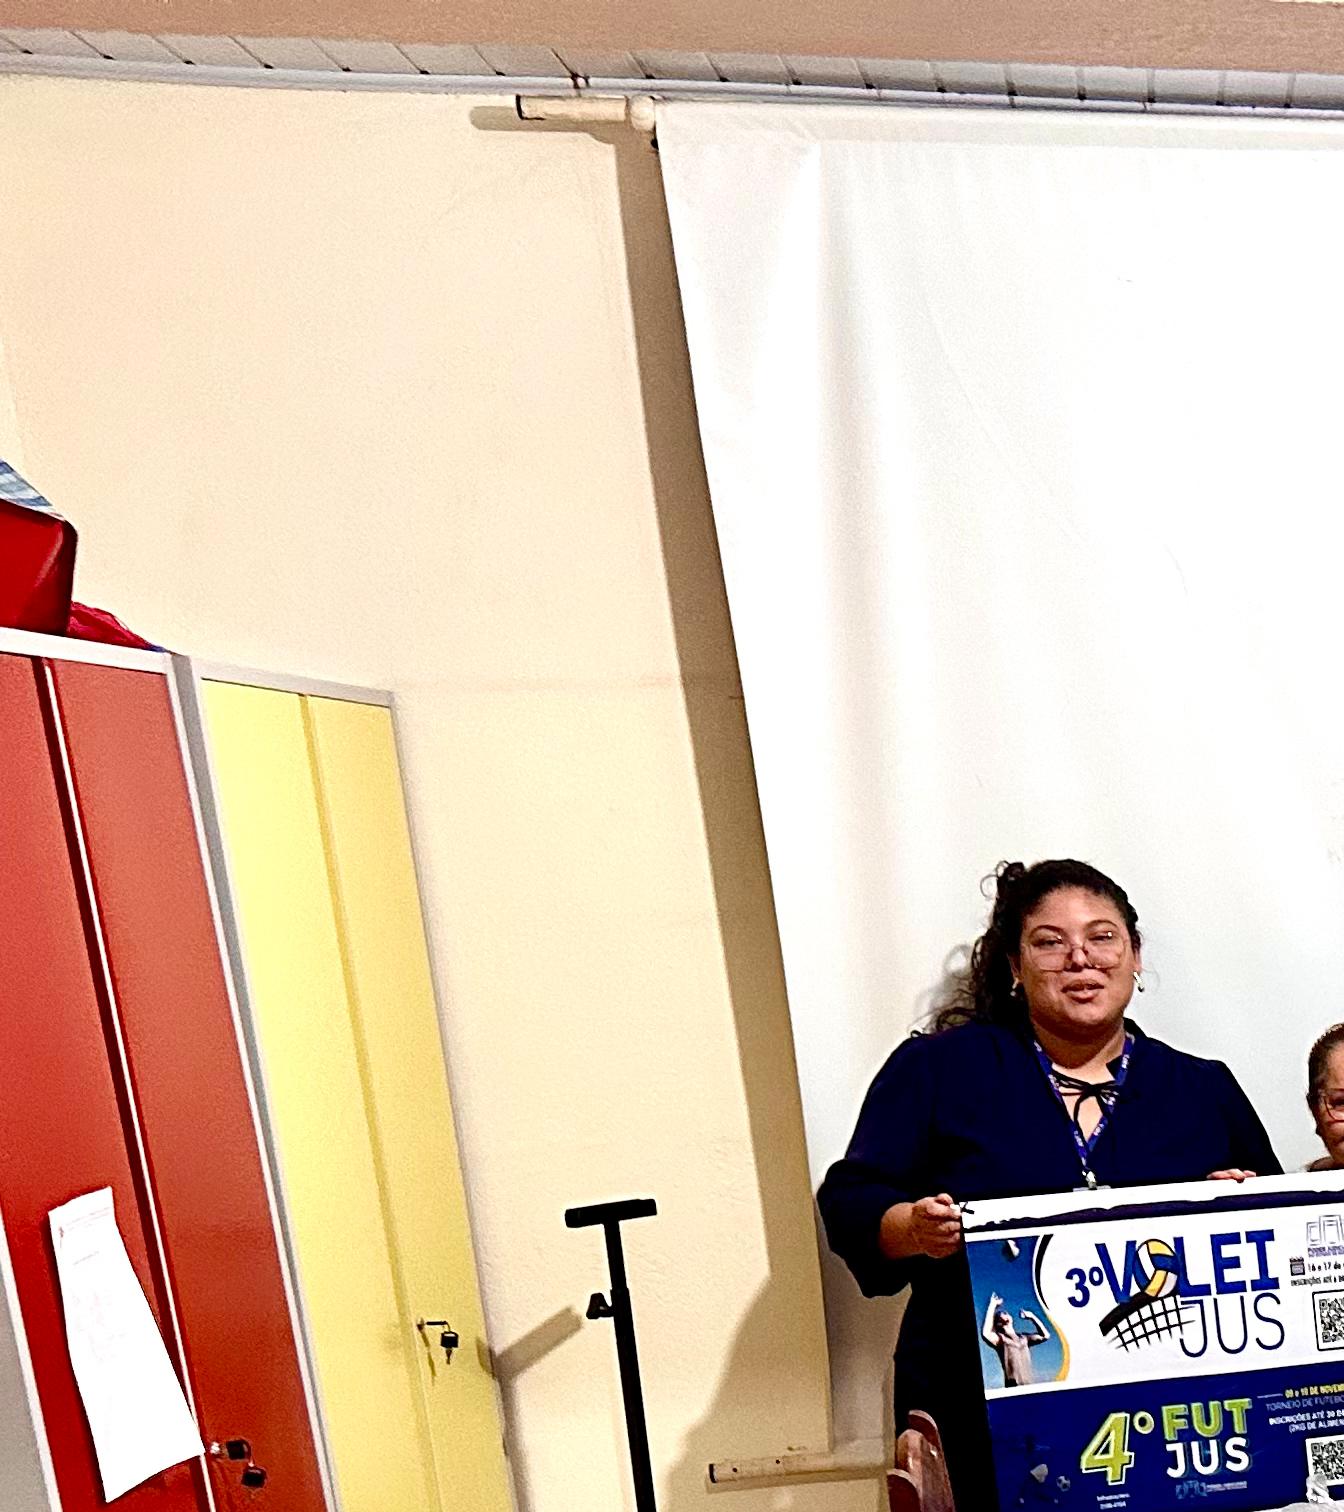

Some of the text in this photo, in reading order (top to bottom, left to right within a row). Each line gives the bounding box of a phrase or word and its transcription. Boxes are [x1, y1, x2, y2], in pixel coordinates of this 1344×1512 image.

[1179, 1292, 1285, 1358] JUS
[1161, 1397, 1253, 1442] FUT
[1302, 1398, 1314, 1408] DE
[1165, 1436, 1252, 1478] JUS
